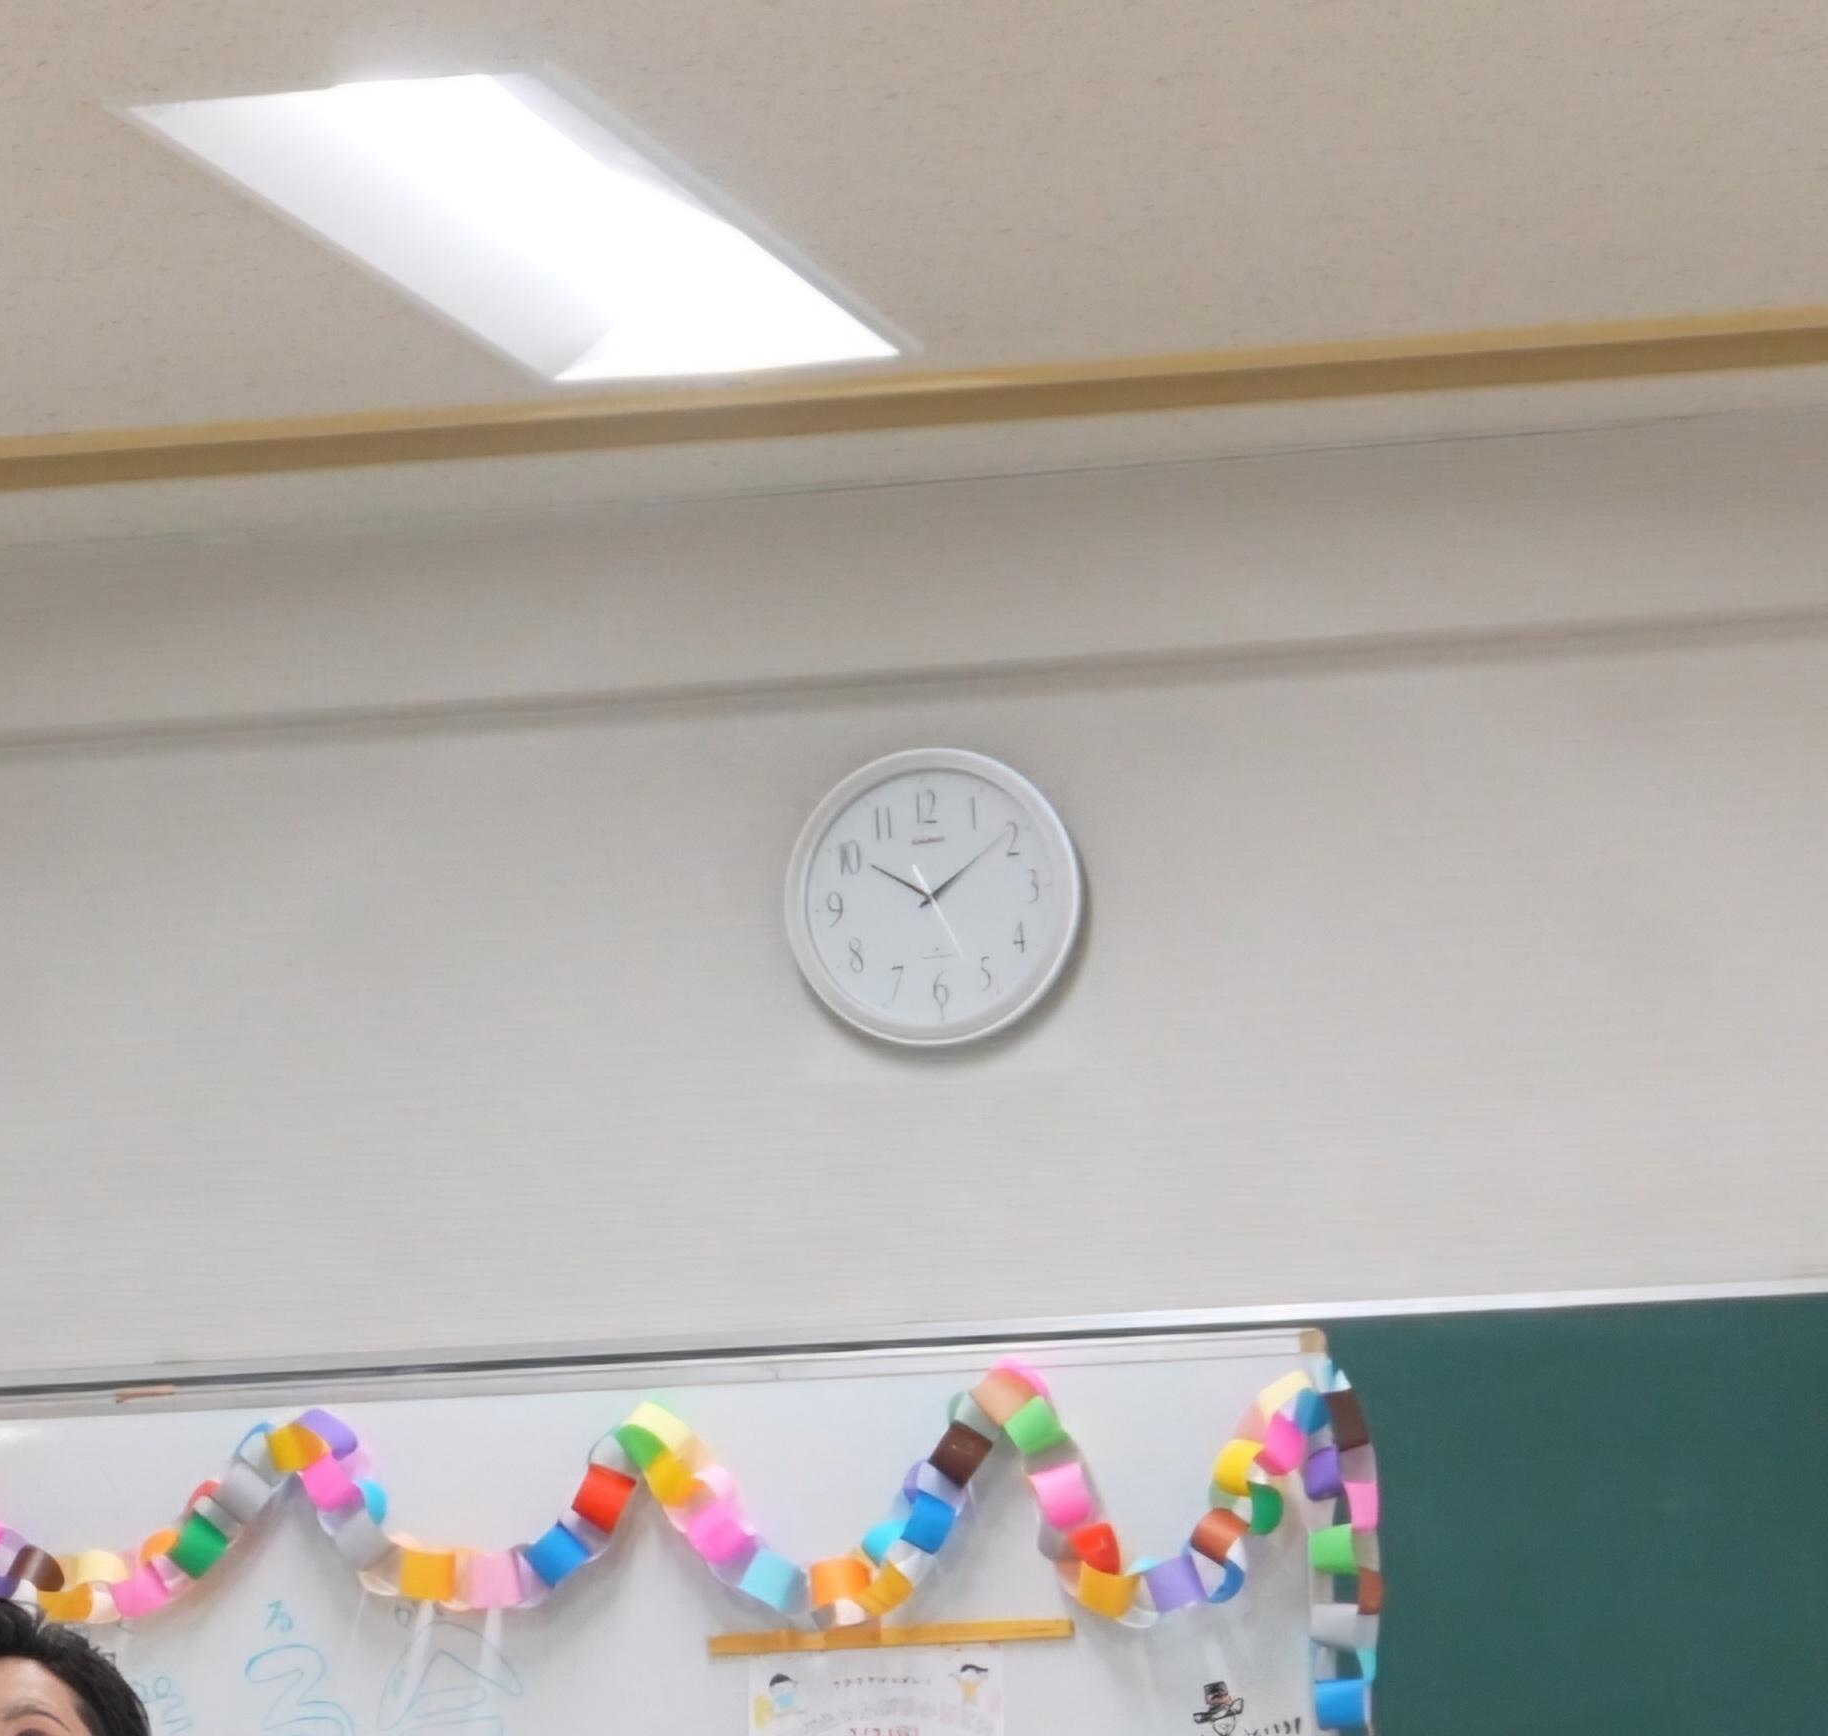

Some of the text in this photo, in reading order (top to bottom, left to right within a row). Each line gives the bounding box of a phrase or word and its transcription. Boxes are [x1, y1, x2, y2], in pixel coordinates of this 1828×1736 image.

[875, 806, 892, 840] 11
[916, 788, 938, 824] 12
[1005, 821, 1021, 857] 2
[839, 839, 861, 876] 10
[1027, 868, 1040, 903] 3
[826, 891, 844, 927] 9
[848, 937, 864, 973] 8
[1012, 920, 1026, 954] 4
[891, 964, 905, 1001] 7
[932, 970, 949, 1009] 6
[979, 955, 993, 991] 5
